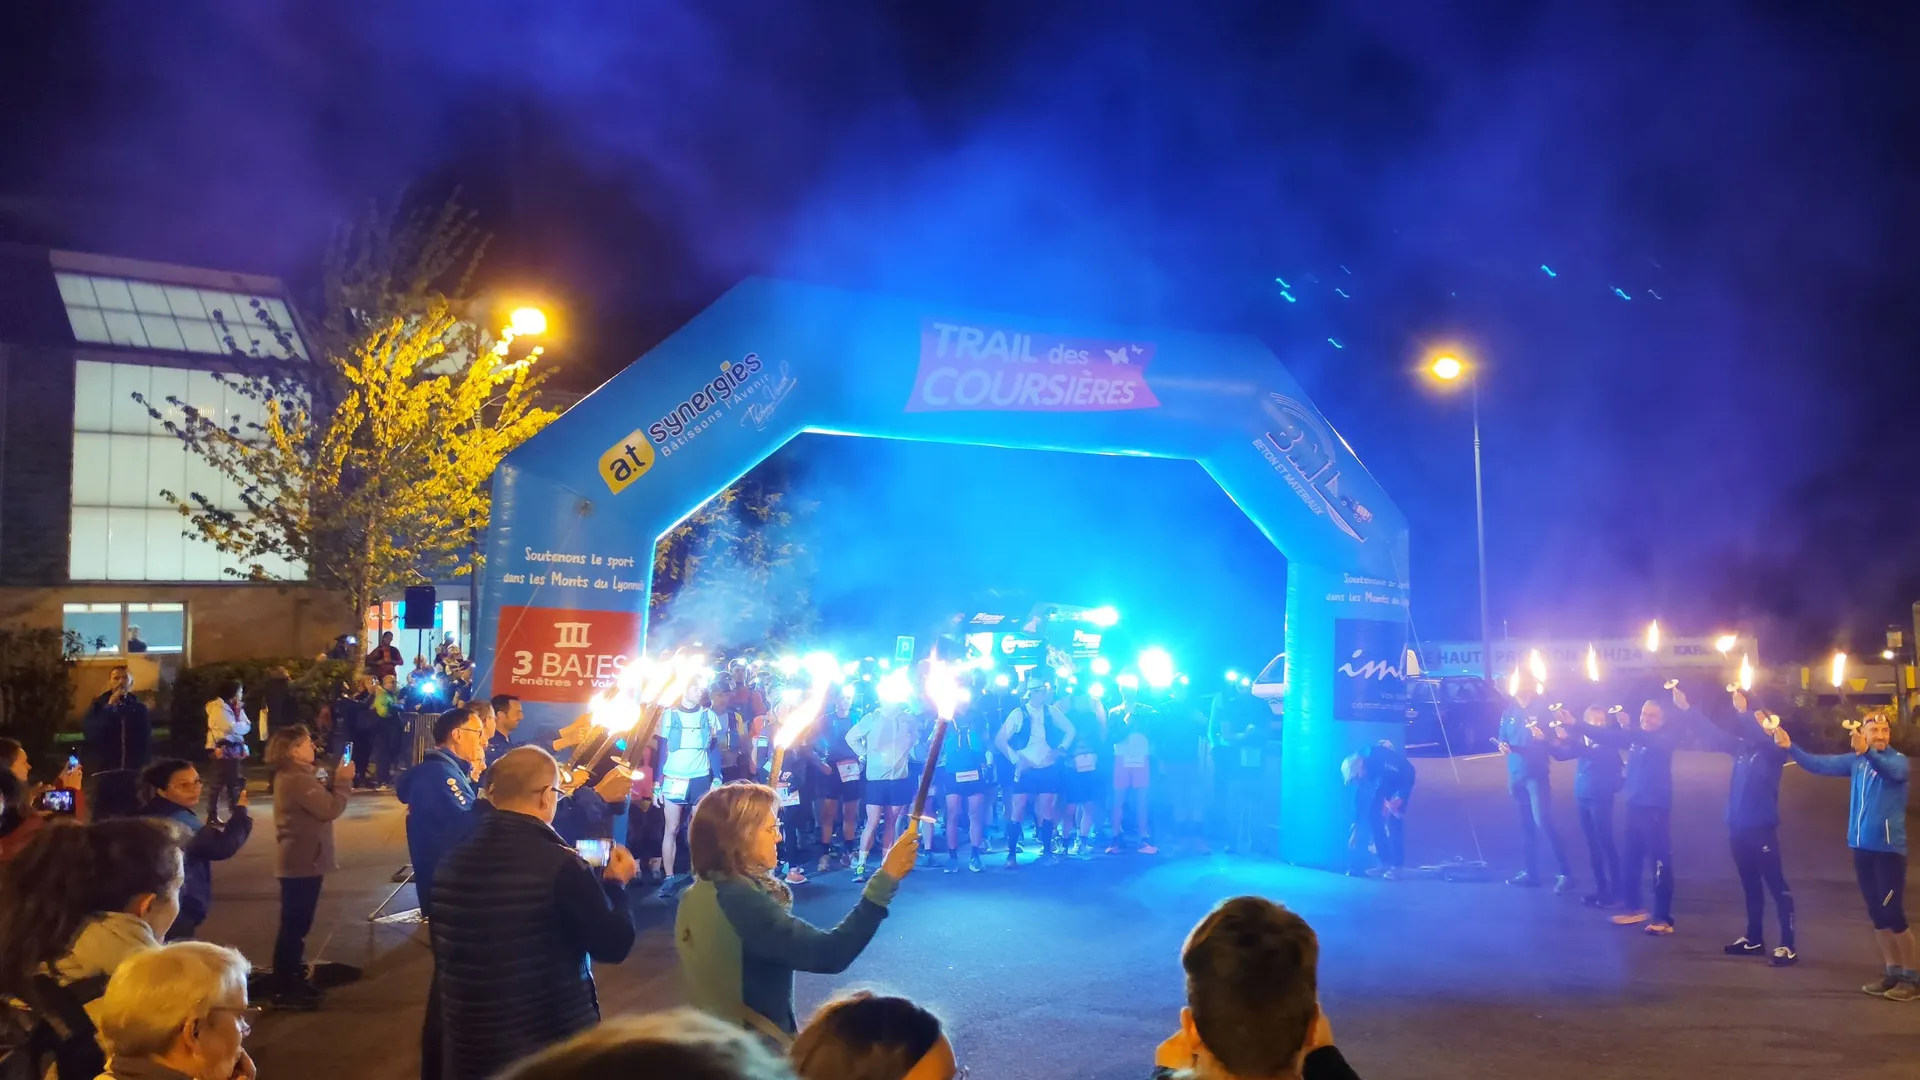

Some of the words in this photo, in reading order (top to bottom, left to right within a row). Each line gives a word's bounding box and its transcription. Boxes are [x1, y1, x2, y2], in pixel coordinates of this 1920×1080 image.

[933, 322, 1038, 364] TRAIL
[1048, 343, 1090, 365] des
[648, 352, 763, 444] synergies
[922, 366, 1138, 407] COURSIÈRES
[660, 410, 723, 457] Bâtissons
[724, 373, 769, 411] l'Avenir
[524, 545, 587, 565] Soutenons
[591, 554, 602, 565] le
[606, 556, 635, 570] sport
[503, 573, 525, 584] dans
[529, 573, 545, 586] les
[551, 571, 589, 588] Monts
[594, 577, 609, 590] du
[511, 676, 572, 688] Fenêtres
[512, 650, 533, 676] 3
[541, 652, 628, 679] BAIES
